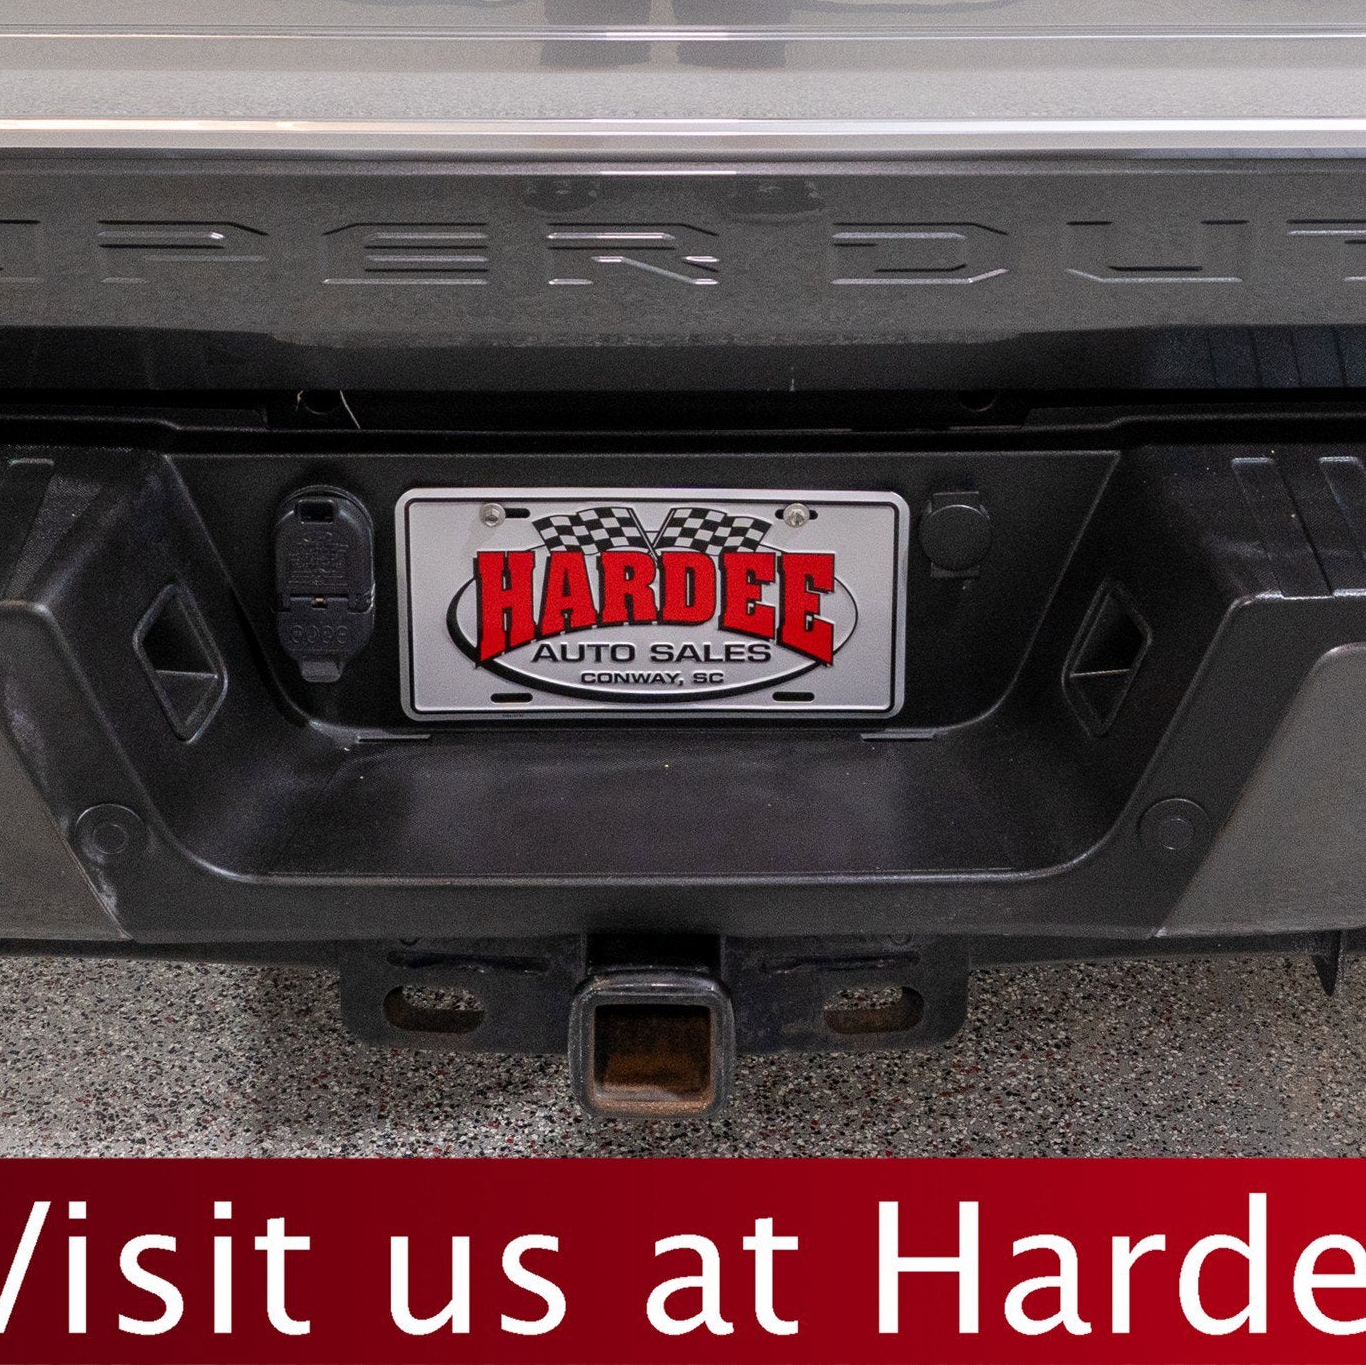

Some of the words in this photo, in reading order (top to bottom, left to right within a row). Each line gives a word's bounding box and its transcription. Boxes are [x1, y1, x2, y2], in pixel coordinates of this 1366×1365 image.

[473, 550, 836, 667] HARDEE
[531, 642, 637, 664] AUTO
[649, 642, 773, 664] SALES
[580, 671, 685, 688] CONWAY,
[692, 671, 725, 686] SC
